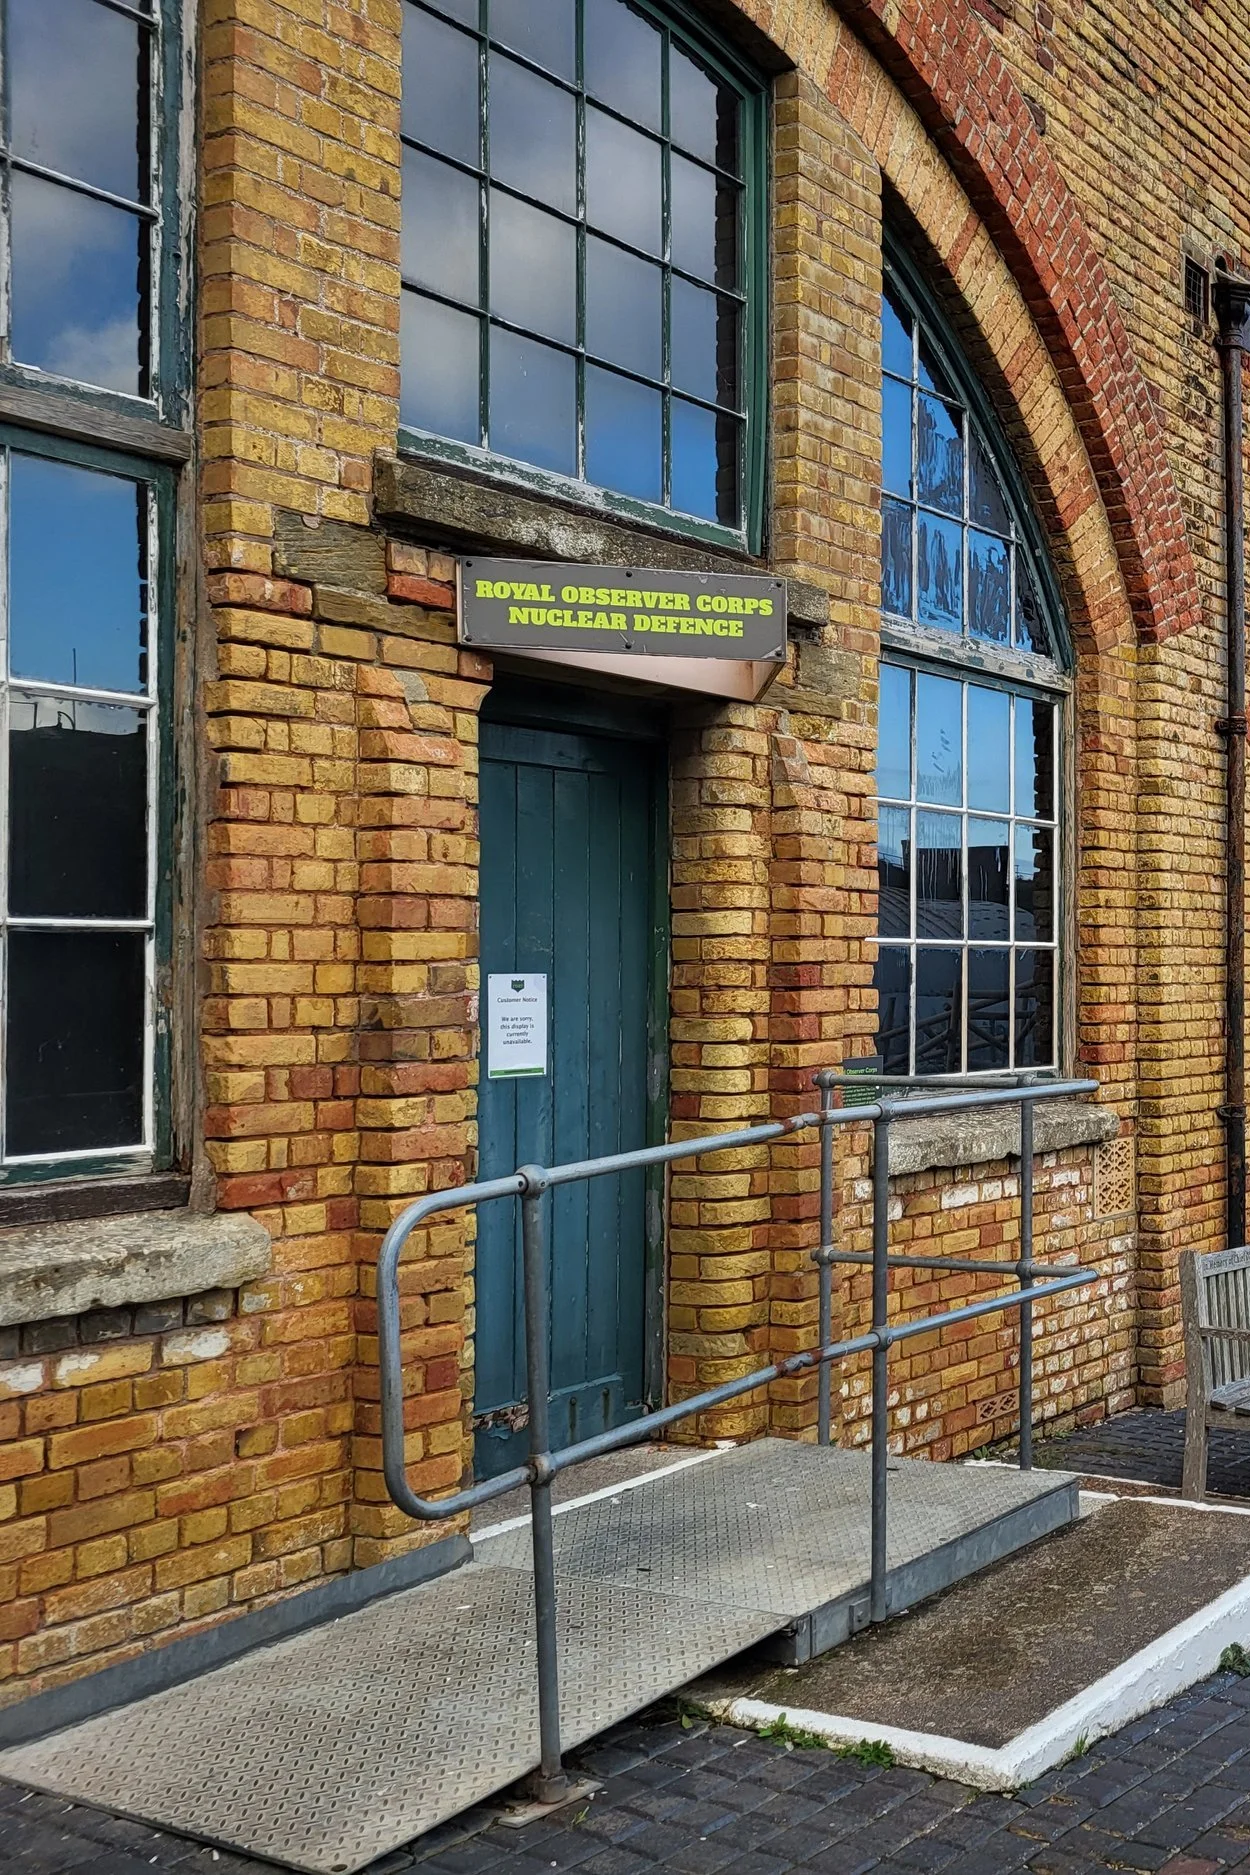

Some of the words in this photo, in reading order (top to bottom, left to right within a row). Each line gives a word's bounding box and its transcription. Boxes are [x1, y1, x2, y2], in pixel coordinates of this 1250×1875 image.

[475, 580, 555, 602] ROYAL
[561, 586, 690, 611] OBSERVER
[696, 594, 773, 616] CORPS
[508, 606, 628, 631] NUCLEAR
[633, 614, 744, 637] DEFENCE
